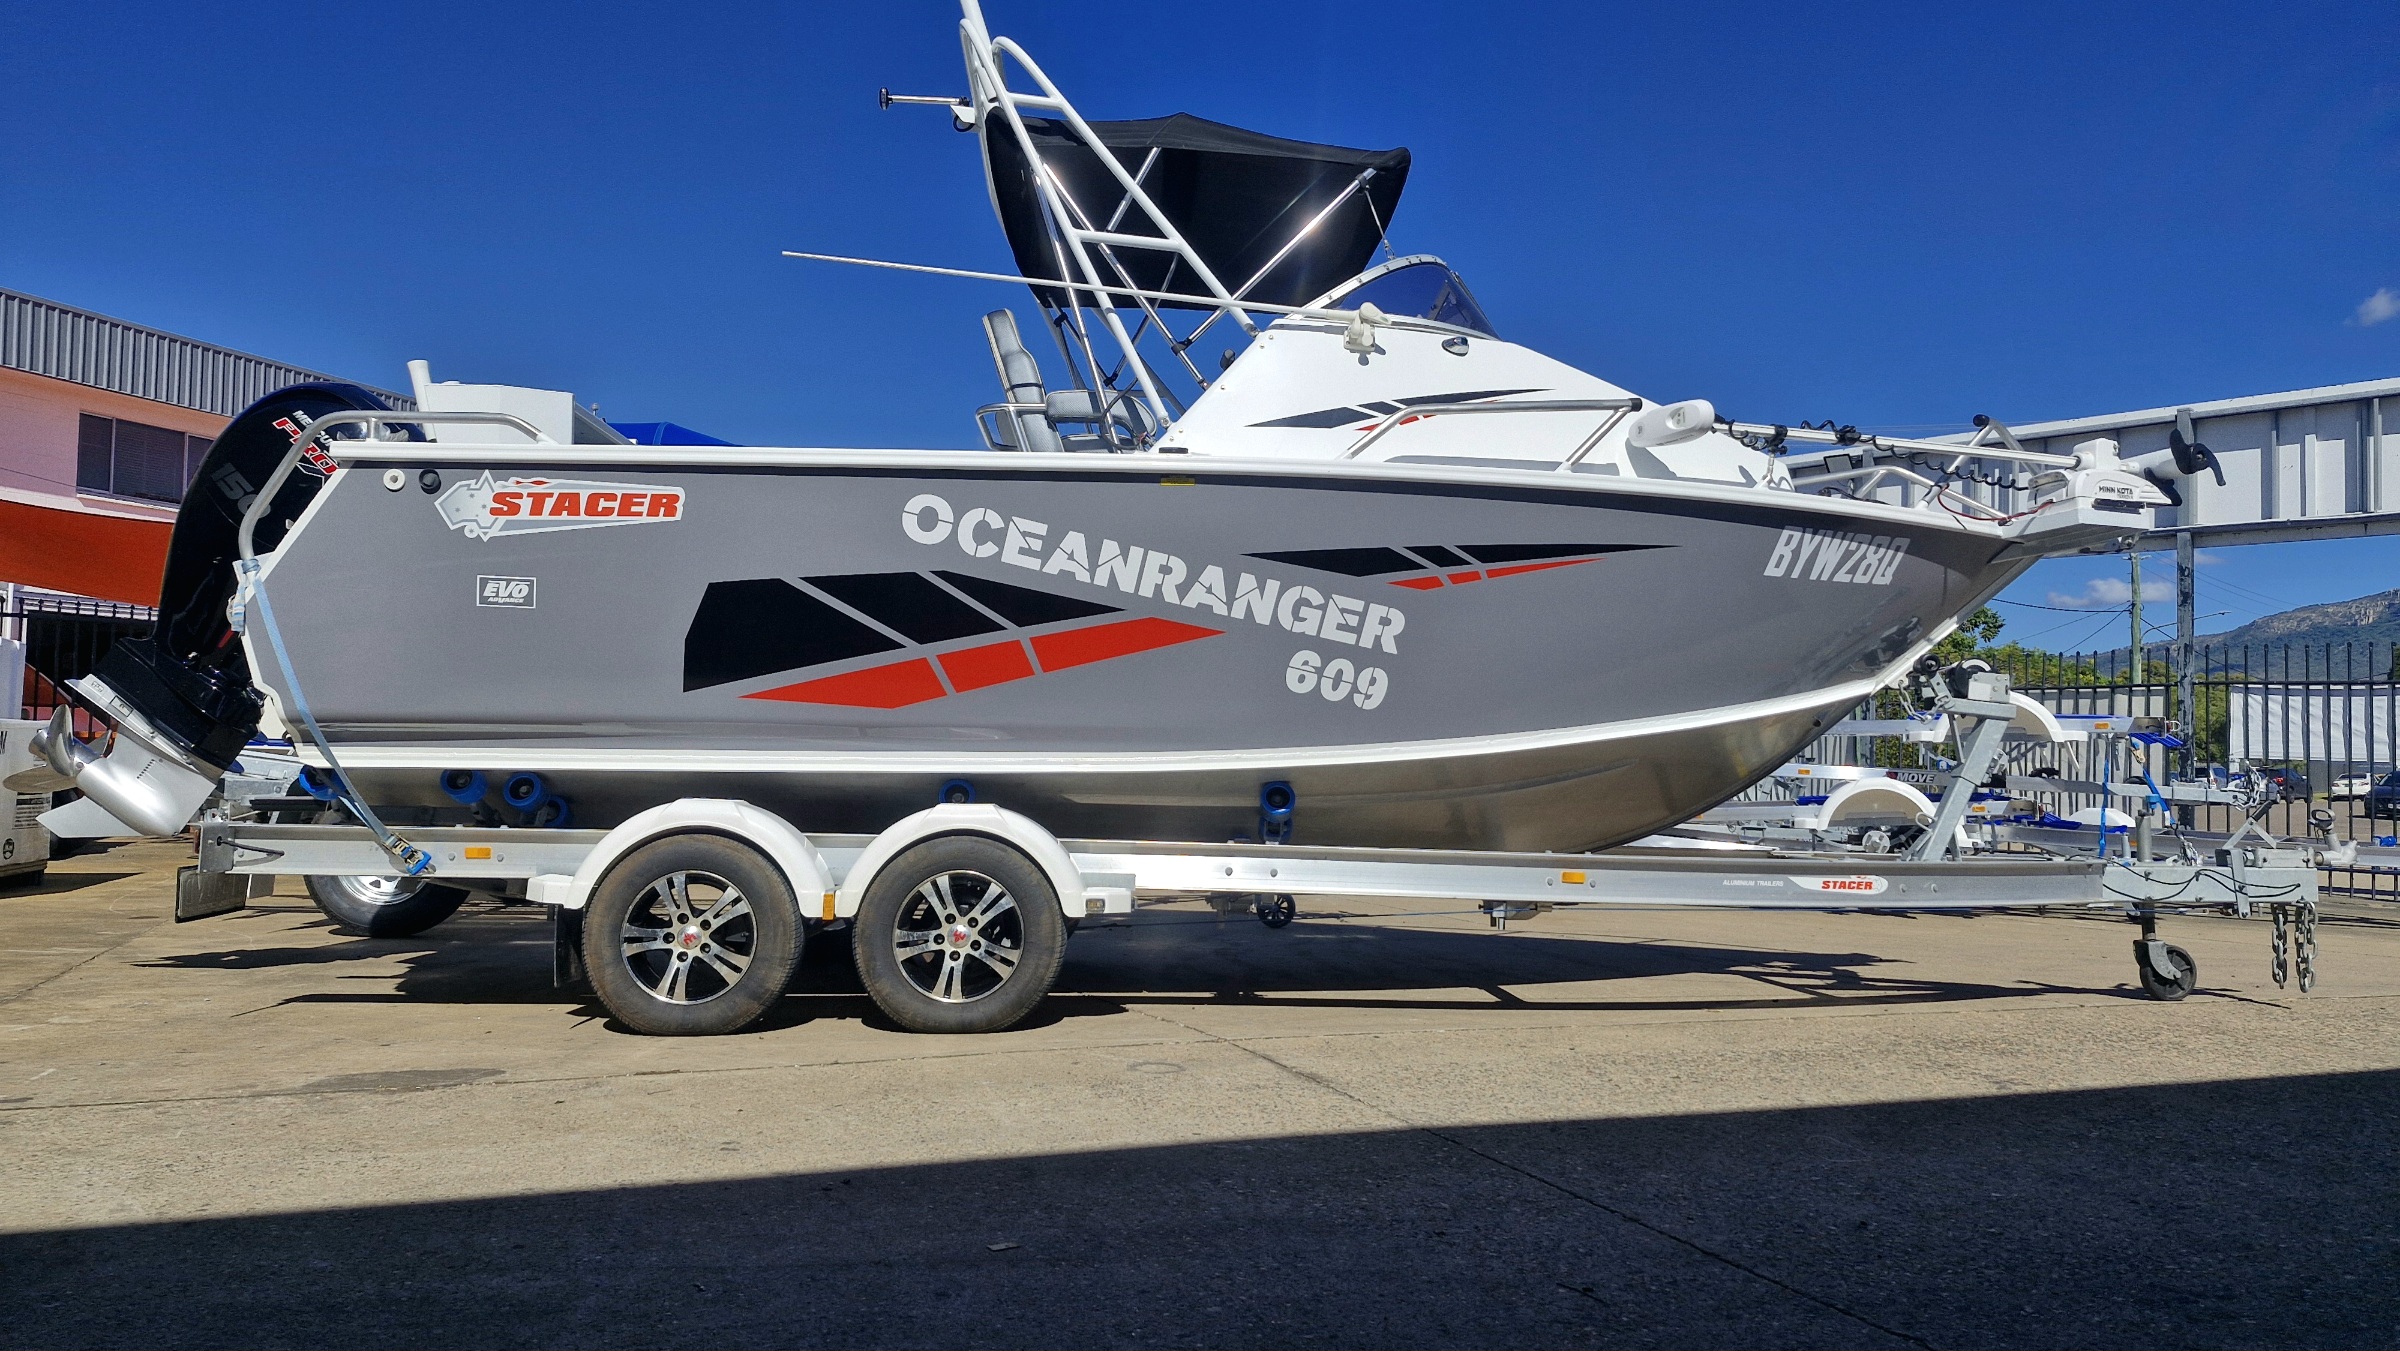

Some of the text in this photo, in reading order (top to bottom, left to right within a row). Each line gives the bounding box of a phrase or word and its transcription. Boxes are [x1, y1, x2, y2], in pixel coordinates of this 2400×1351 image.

[489, 491, 681, 518] STACER
[1763, 525, 1911, 586] BYW28Q
[901, 493, 1406, 655] OCEANRANGER
[483, 580, 531, 598] EVO
[1285, 649, 1389, 710] 609
[1896, 771, 1936, 784] MOVE
[1722, 879, 1755, 887] ALUMINIUM
[1821, 880, 1874, 890] STACER
